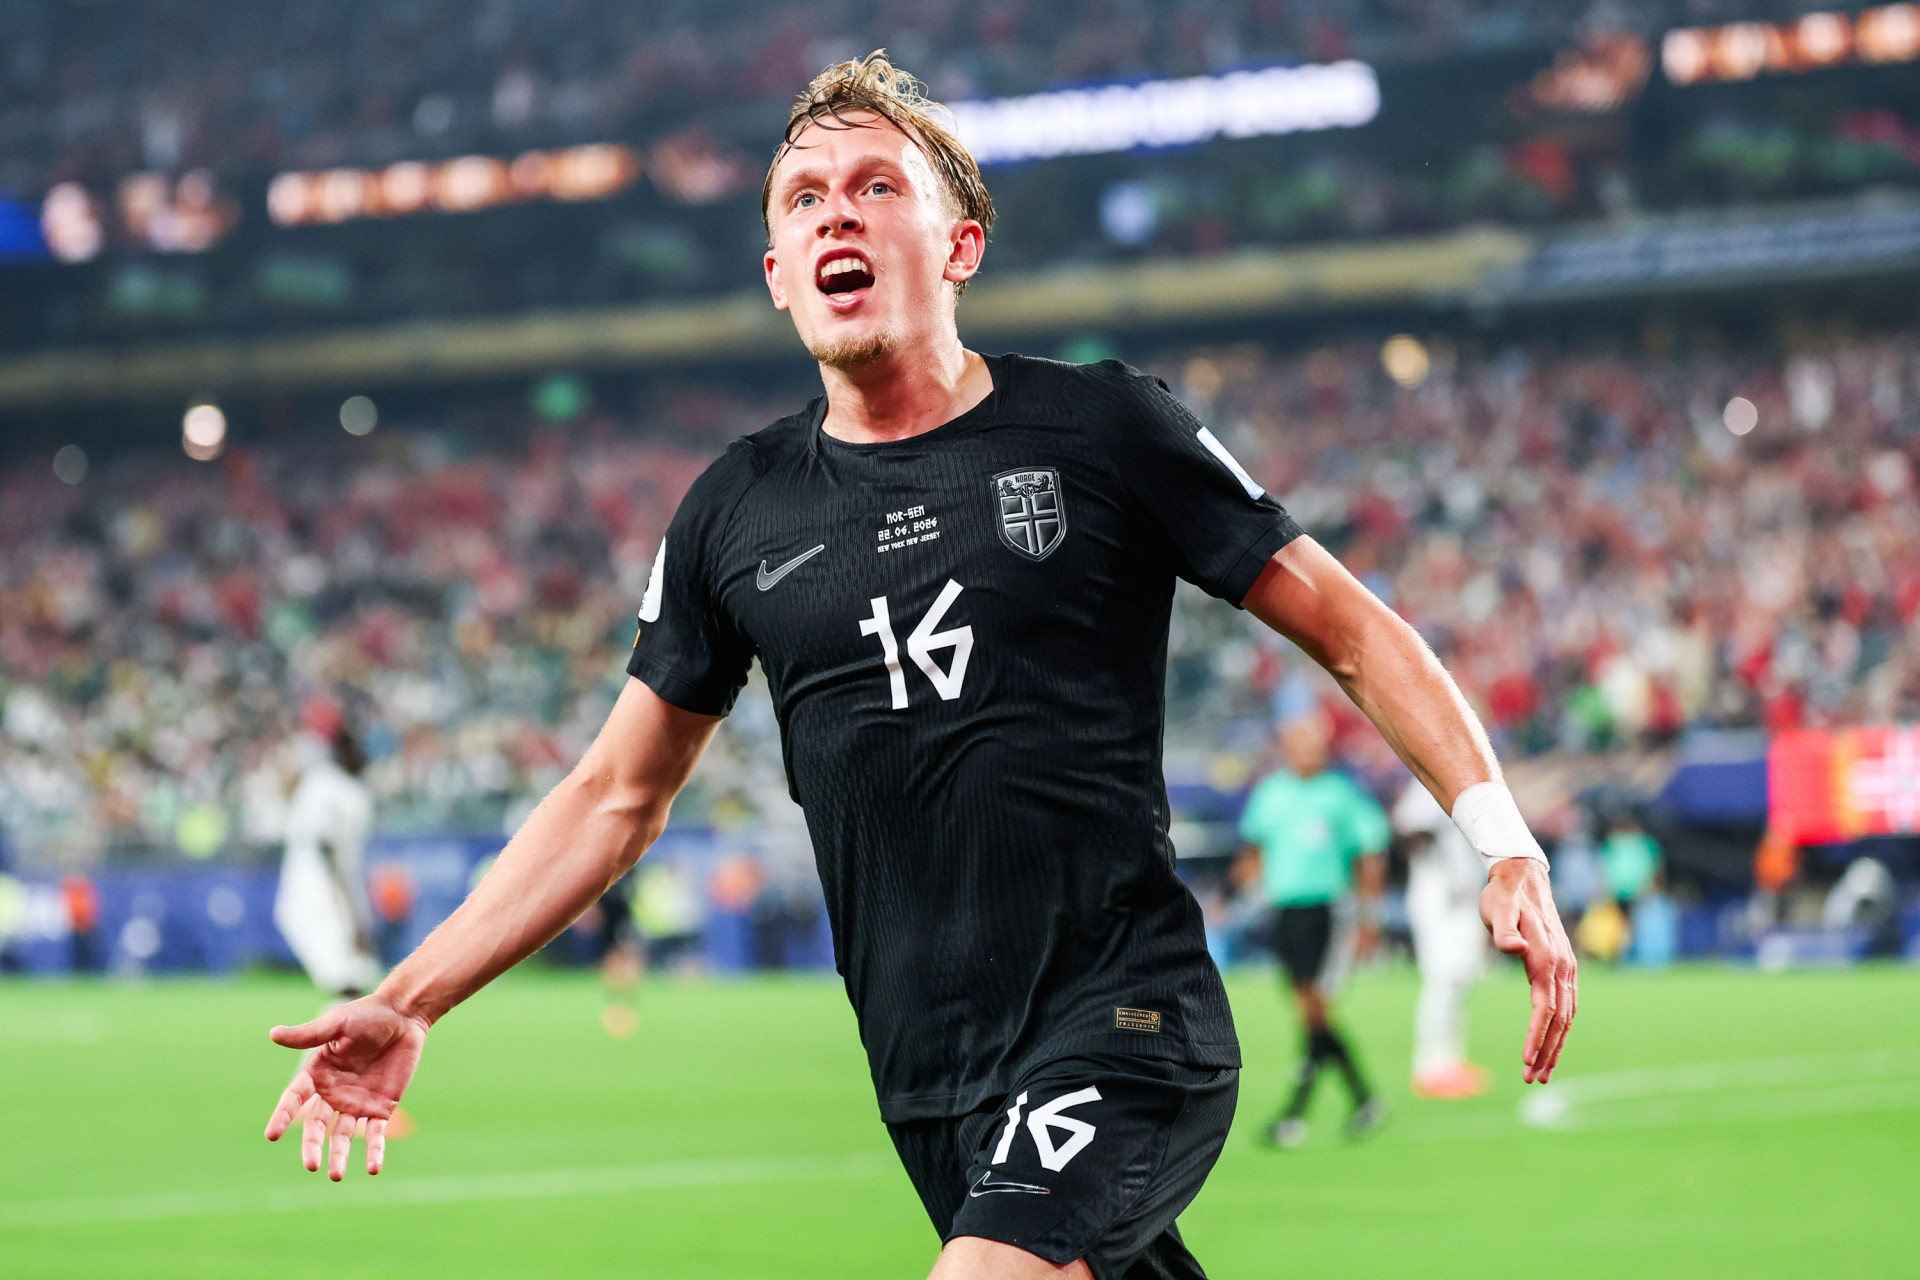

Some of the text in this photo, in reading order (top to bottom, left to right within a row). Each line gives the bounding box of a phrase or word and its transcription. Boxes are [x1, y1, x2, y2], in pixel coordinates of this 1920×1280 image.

[1015, 473, 1035, 483] NORGE
[886, 505, 925, 524] NOR-SEN
[877, 531, 940, 553] NEW YORK NEW JERSEY
[859, 578, 974, 710] 16
[991, 1085, 1103, 1172] 16
